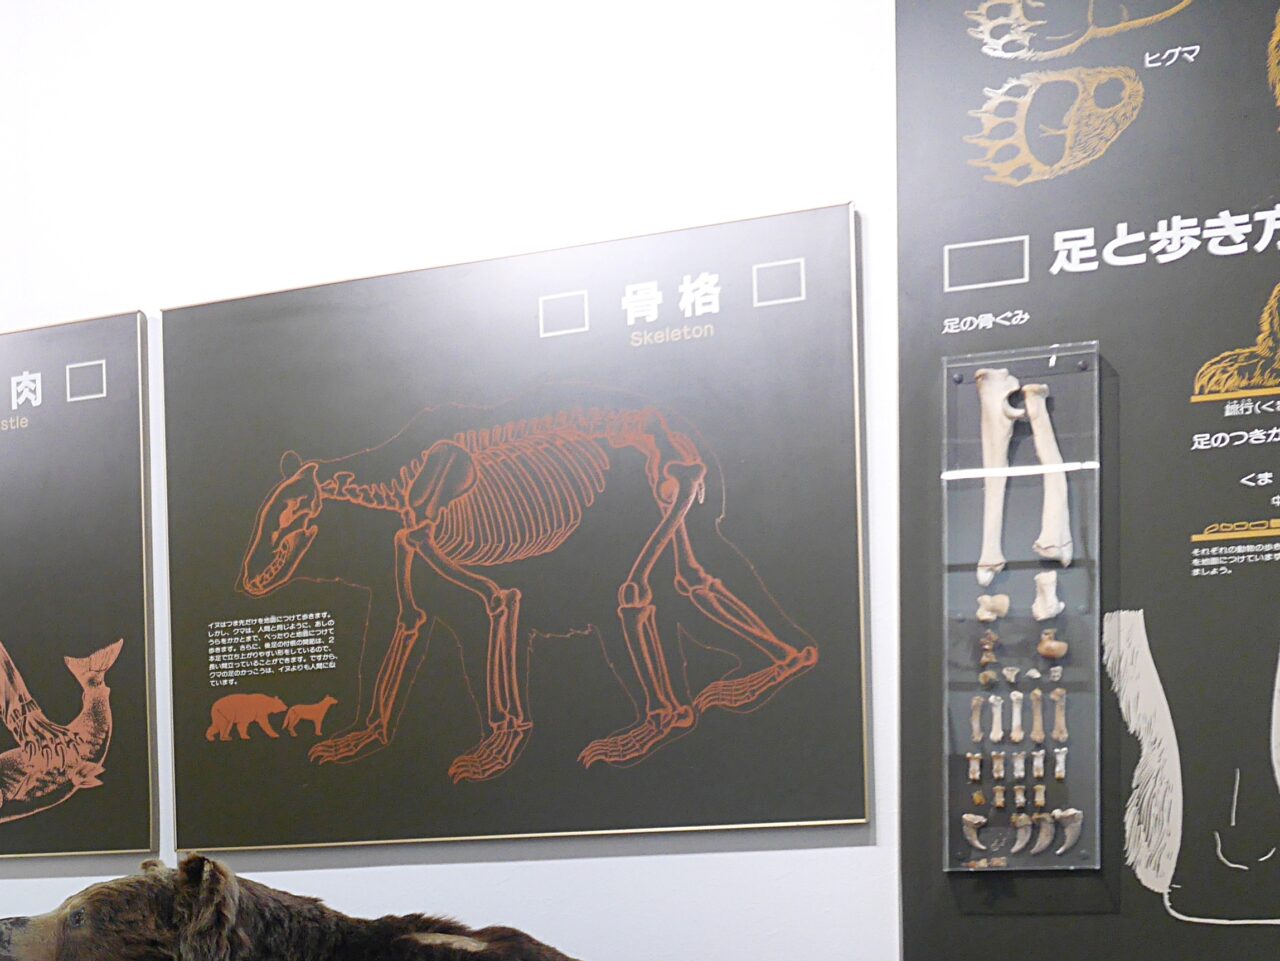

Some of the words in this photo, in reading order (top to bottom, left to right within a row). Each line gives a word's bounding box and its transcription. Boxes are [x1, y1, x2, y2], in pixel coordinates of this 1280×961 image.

[1144, 45, 1200, 68] ヒグマ
[942, 309, 1030, 334] 足の骨ぐみ
[630, 323, 715, 347] Skeleton
[1240, 471, 1273, 487] くま
